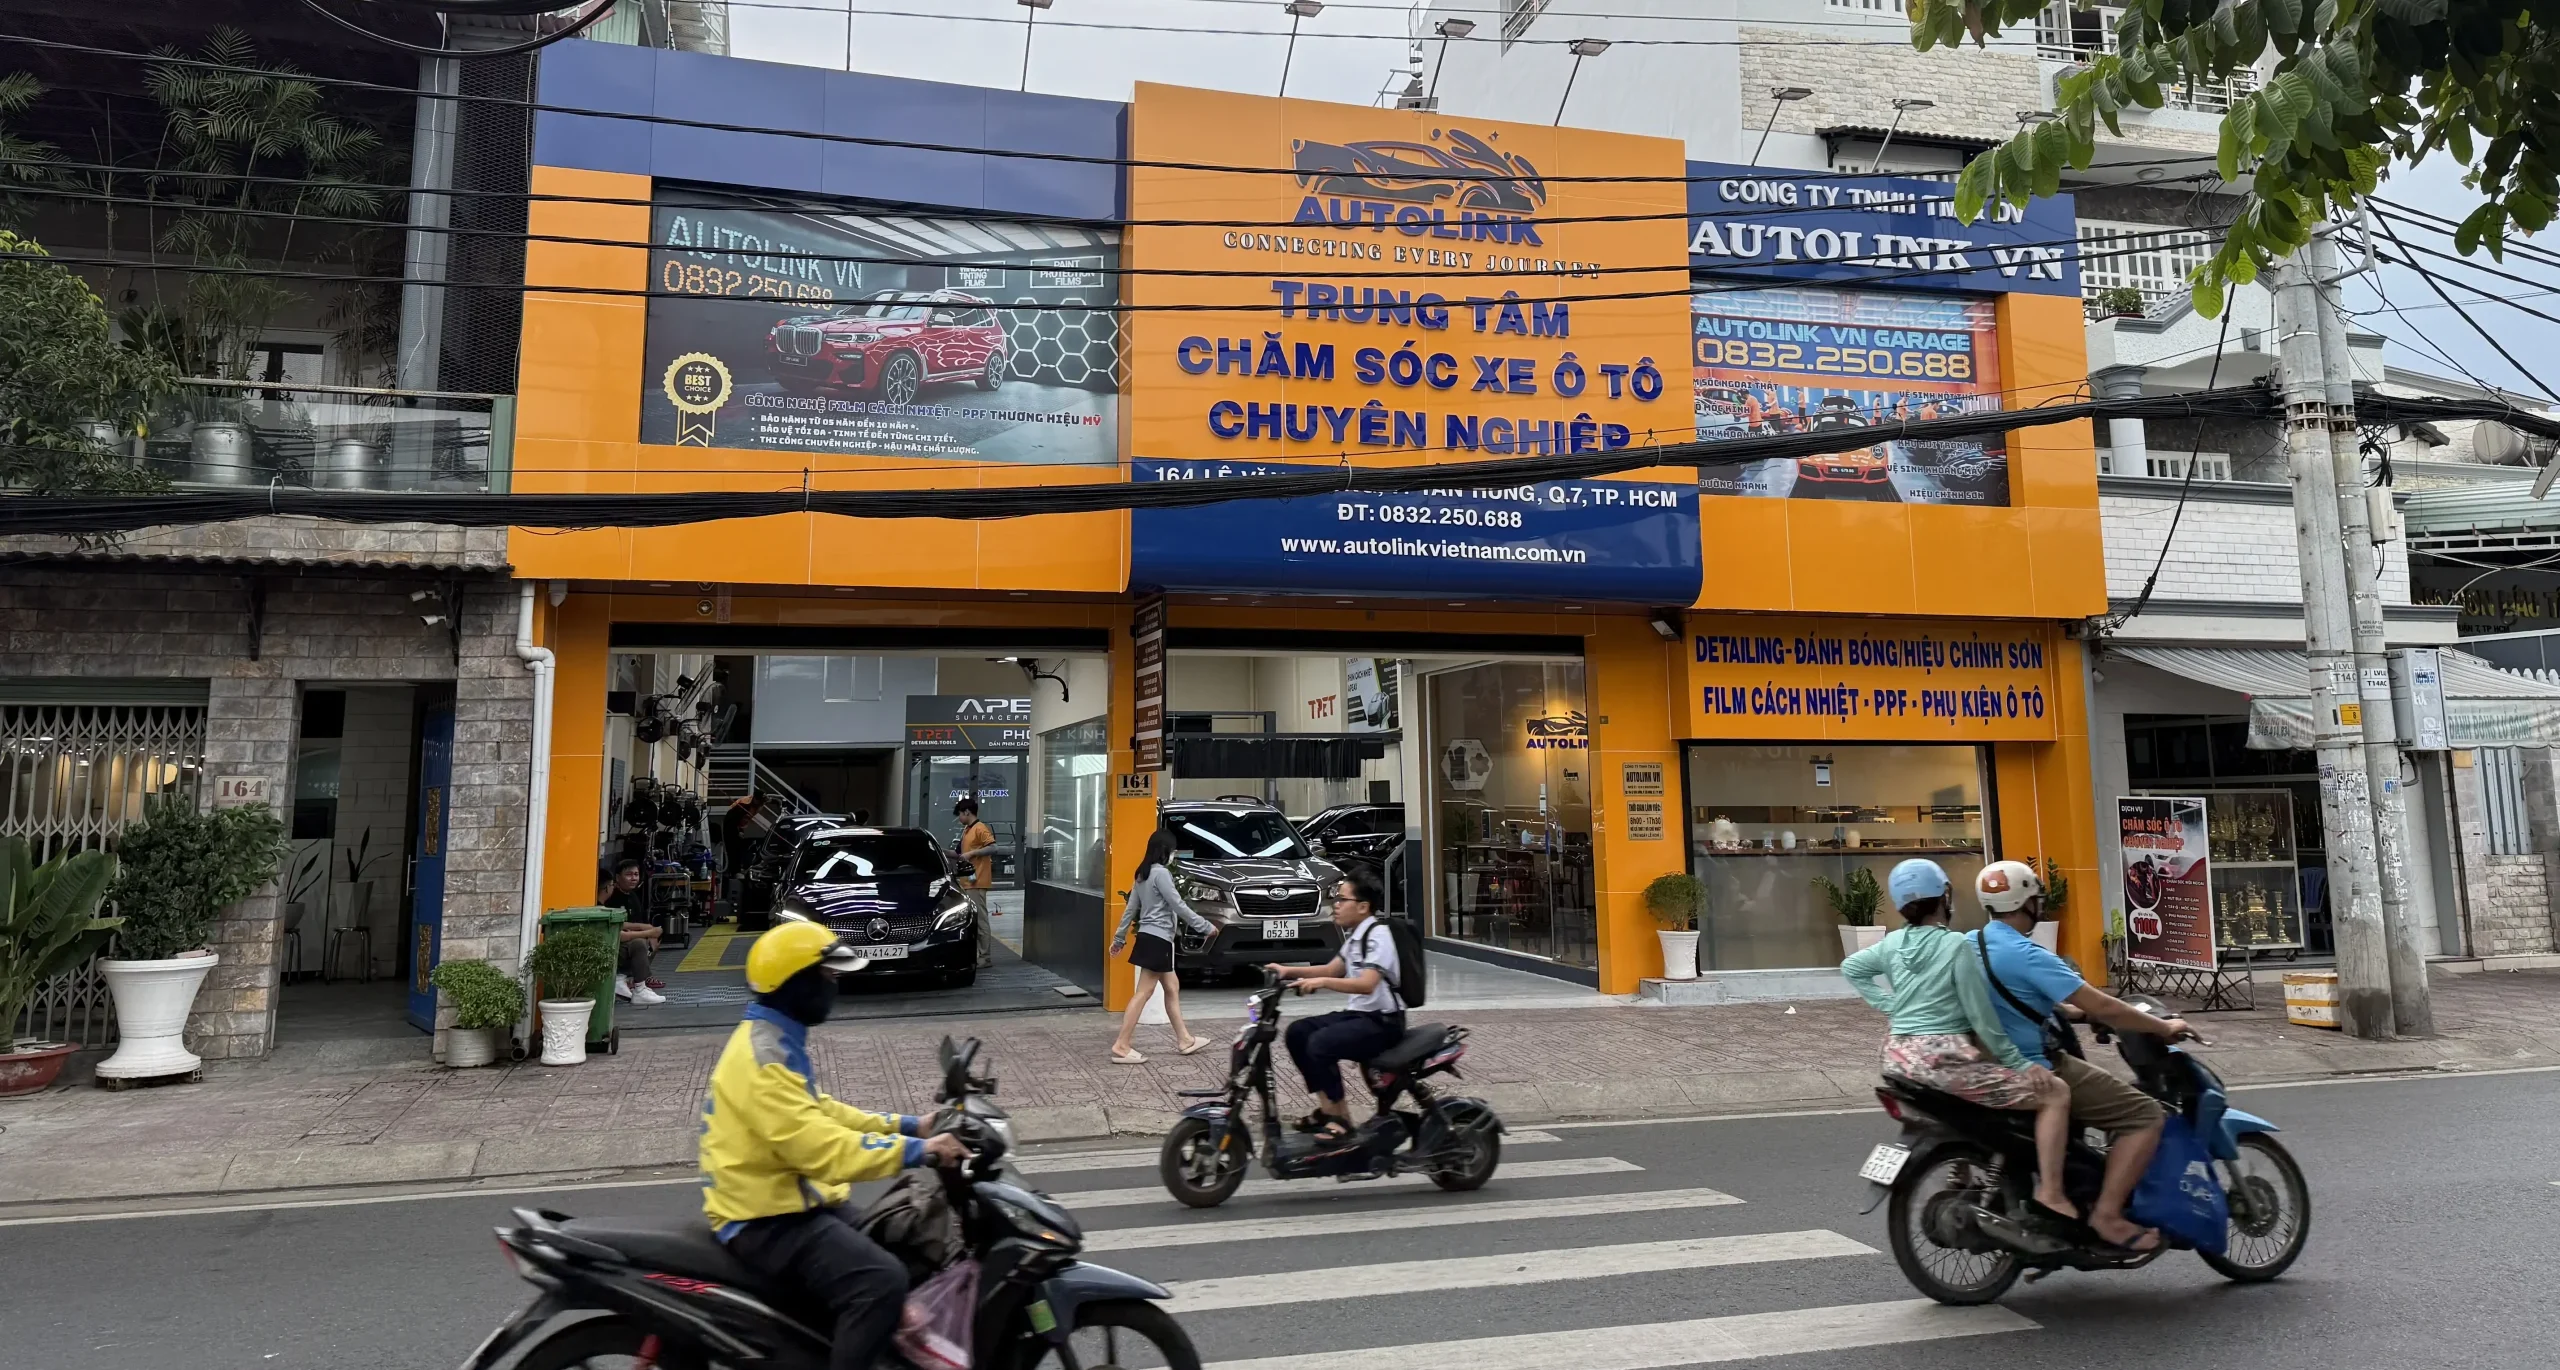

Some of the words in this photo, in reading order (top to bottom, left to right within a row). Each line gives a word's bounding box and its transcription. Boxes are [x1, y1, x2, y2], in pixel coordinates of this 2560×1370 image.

[1805, 185, 1839, 206] TY
[1847, 188, 1917, 214] TNHH
[1293, 195, 1545, 247] AUTOLINK
[666, 216, 824, 283] AUTOLINK
[833, 257, 863, 289] VN
[1223, 231, 1383, 261] CONNECTING
[1394, 245, 1473, 268] EVERY
[1485, 254, 1602, 280] JOURNEY
[1688, 221, 1977, 274] AUTOLINK
[1988, 243, 2065, 281] VN
[1053, 260, 1080, 268] PAINT
[959, 272, 987, 280] TINTING
[1040, 270, 1095, 278] PROTECTION
[1055, 278, 1082, 286] FILMS
[964, 279, 986, 287] FILMS
[1271, 280, 1450, 331] TRUNG
[1465, 290, 1571, 338] TÂM
[1695, 317, 1821, 343] AUTOLINK
[1830, 327, 1866, 346] VN
[1874, 330, 1970, 352] GARAGE
[1696, 338, 1971, 378] 0832.250.688
[1176, 331, 1336, 380] CHĂM
[1354, 340, 1459, 390] SÓC
[1470, 355, 1539, 395] XE
[1551, 351, 1587, 398] Ô
[1598, 356, 1665, 402] TÔ
[684, 374, 712, 386] BEST
[1912, 391, 1935, 399] SINH
[744, 392, 784, 408] CÔNG
[787, 396, 827, 413] NGHỆ
[828, 400, 865, 413] FILM
[868, 400, 906, 415] CÁCH
[906, 402, 951, 419] NHIỆT
[962, 408, 987, 419] PPF
[989, 409, 1044, 423] THƯƠNG
[1046, 412, 1080, 427] HIỆU
[1082, 414, 1102, 426] MỸ
[760, 414, 779, 423] BẢO
[781, 415, 807, 424] HÀNH
[808, 416, 821, 425] TỪ
[836, 418, 856, 427] NĂM
[857, 418, 876, 428] ĐẾN
[877, 421, 888, 429] 10
[889, 422, 909, 430] NĂM
[1208, 399, 1427, 448] CHUYÊN
[760, 425, 779, 434] BẢO
[781, 426, 793, 436] VỆ
[795, 426, 812, 435] TỐI
[833, 430, 856, 438] TINH
[858, 428, 870, 438] TẾ
[871, 428, 889, 439] ĐẾN
[891, 431, 914, 441] TỪNG
[915, 434, 930, 442] CHI
[760, 436, 777, 444] THI
[779, 436, 803, 445] CÔNG
[805, 438, 841, 447] CHUYÊN
[842, 440, 878, 450] NGHIỆP
[884, 442, 902, 452] HẬU
[904, 443, 922, 452] MÃI
[923, 442, 945, 453] CHẤT
[1939, 441, 1969, 450] TRONG
[1970, 442, 1983, 451] XE
[1155, 466, 1194, 481] 164
[1887, 463, 1898, 474] VỆ
[1900, 465, 1925, 473] SINH
[1925, 465, 1963, 475] KHOANG
[1735, 481, 1768, 490] NHANH
[1909, 488, 1933, 499] HIỆU
[1966, 490, 1985, 500] SƠN
[1337, 503, 1375, 522] ĐT:
[1379, 506, 1523, 528] 0832.250.688
[1281, 536, 1586, 564] www.autolinkvietnam.com.vn
[1950, 631, 2004, 669] CHỈNH
[2008, 638, 2043, 669] SƠN
[1308, 694, 1336, 720] TPET
[1704, 686, 1747, 714] FILM
[1751, 681, 1801, 715] CÁCH
[1806, 681, 1859, 723] NHIỆT
[1873, 689, 1907, 716] PPF
[1922, 690, 1957, 725] PHỤ
[1961, 684, 2002, 725] KIỆN
[2006, 684, 2018, 719] Ô
[2021, 684, 2044, 719] TÔ
[912, 729, 955, 740] TPET
[1121, 774, 1150, 788] 164
[2121, 805, 2135, 813] DỊCH
[2135, 805, 2143, 814] VỤ
[2122, 816, 2145, 831] CHĂM
[2146, 816, 2162, 831] SÓC
[2164, 816, 2170, 832] Ô
[1273, 921, 1288, 929] 51K
[2133, 917, 2159, 935] 110K
[1266, 930, 1295, 938] 052.38
[854, 947, 903, 959] 0A-414.27
